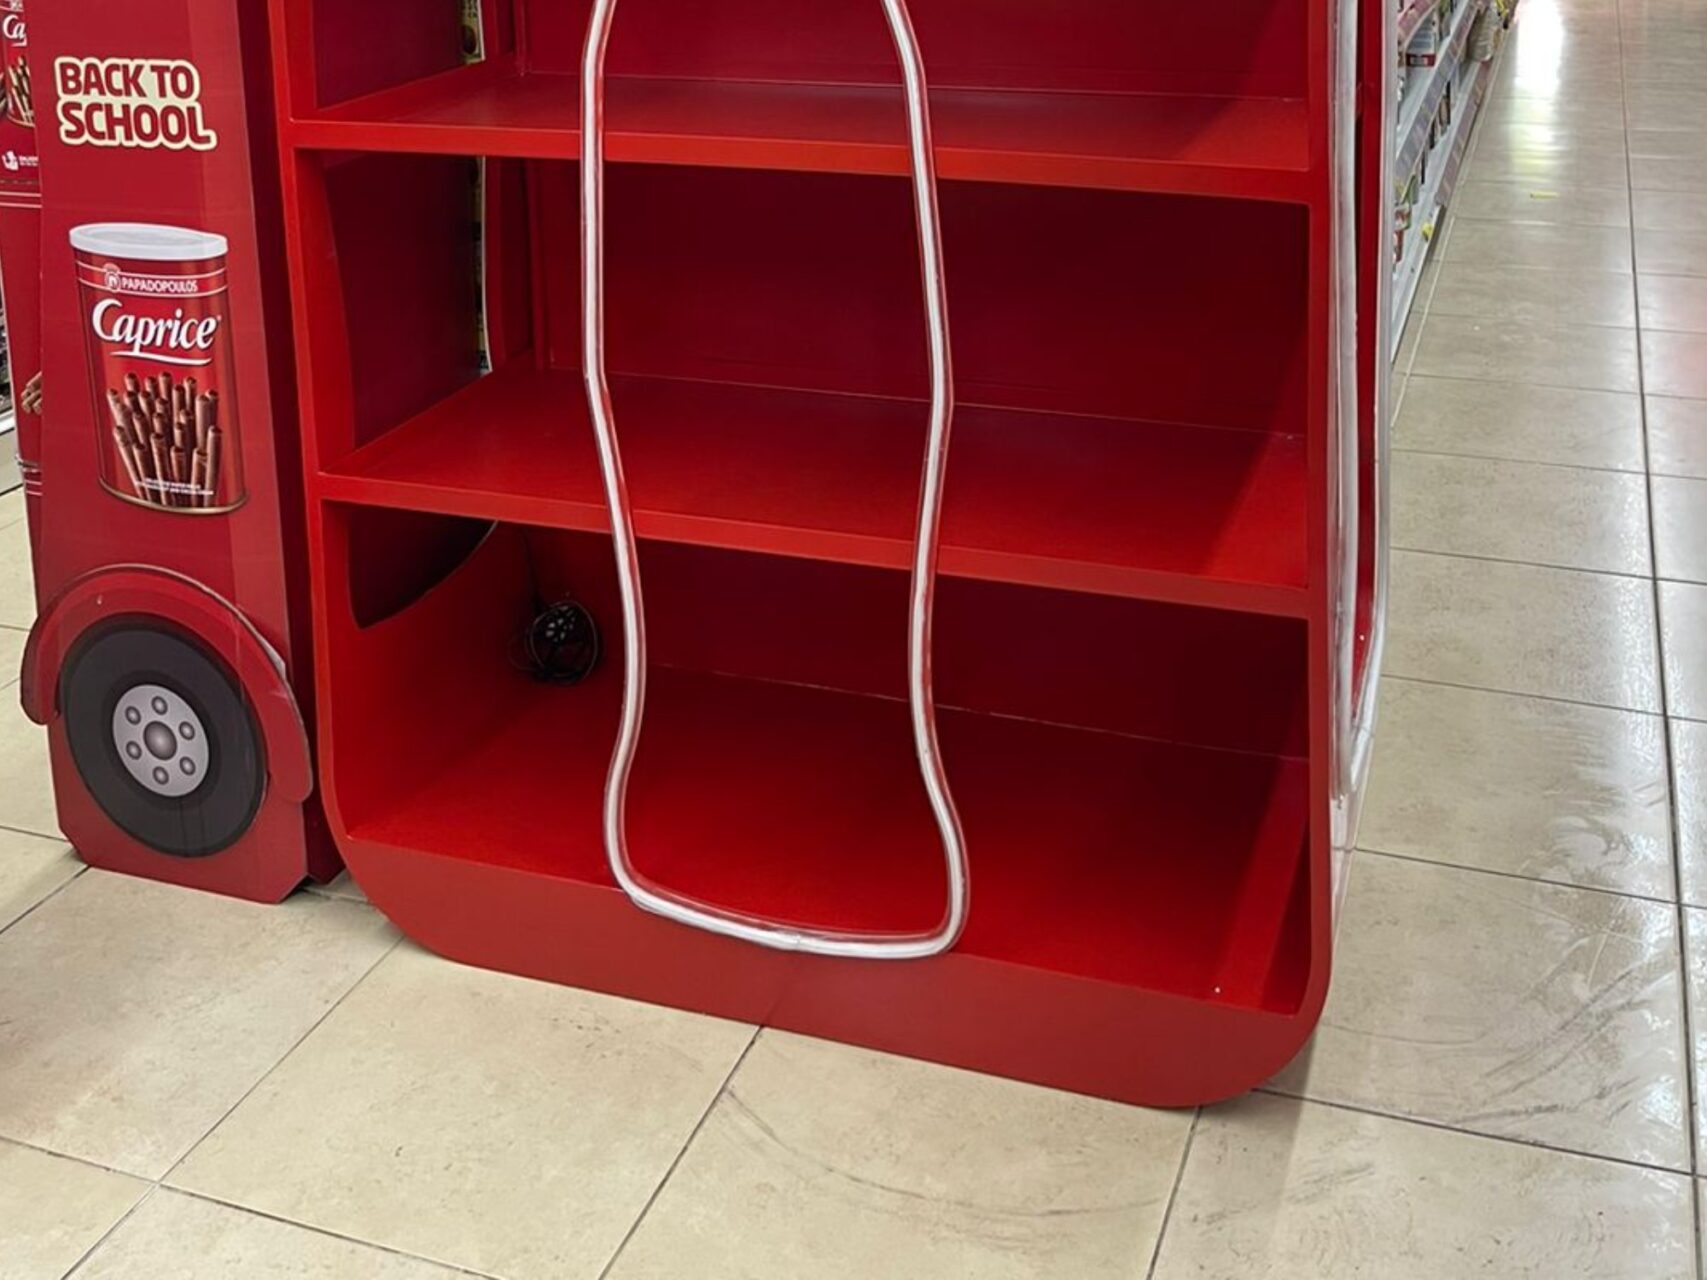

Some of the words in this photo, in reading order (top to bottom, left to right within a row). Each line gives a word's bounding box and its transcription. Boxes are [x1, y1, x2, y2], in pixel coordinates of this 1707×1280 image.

[58, 61, 148, 99] BACK
[151, 62, 194, 99] TO
[61, 102, 213, 144] SCHOOL
[121, 277, 199, 293] PAPADOPOULOS
[92, 299, 218, 354] Caprice
